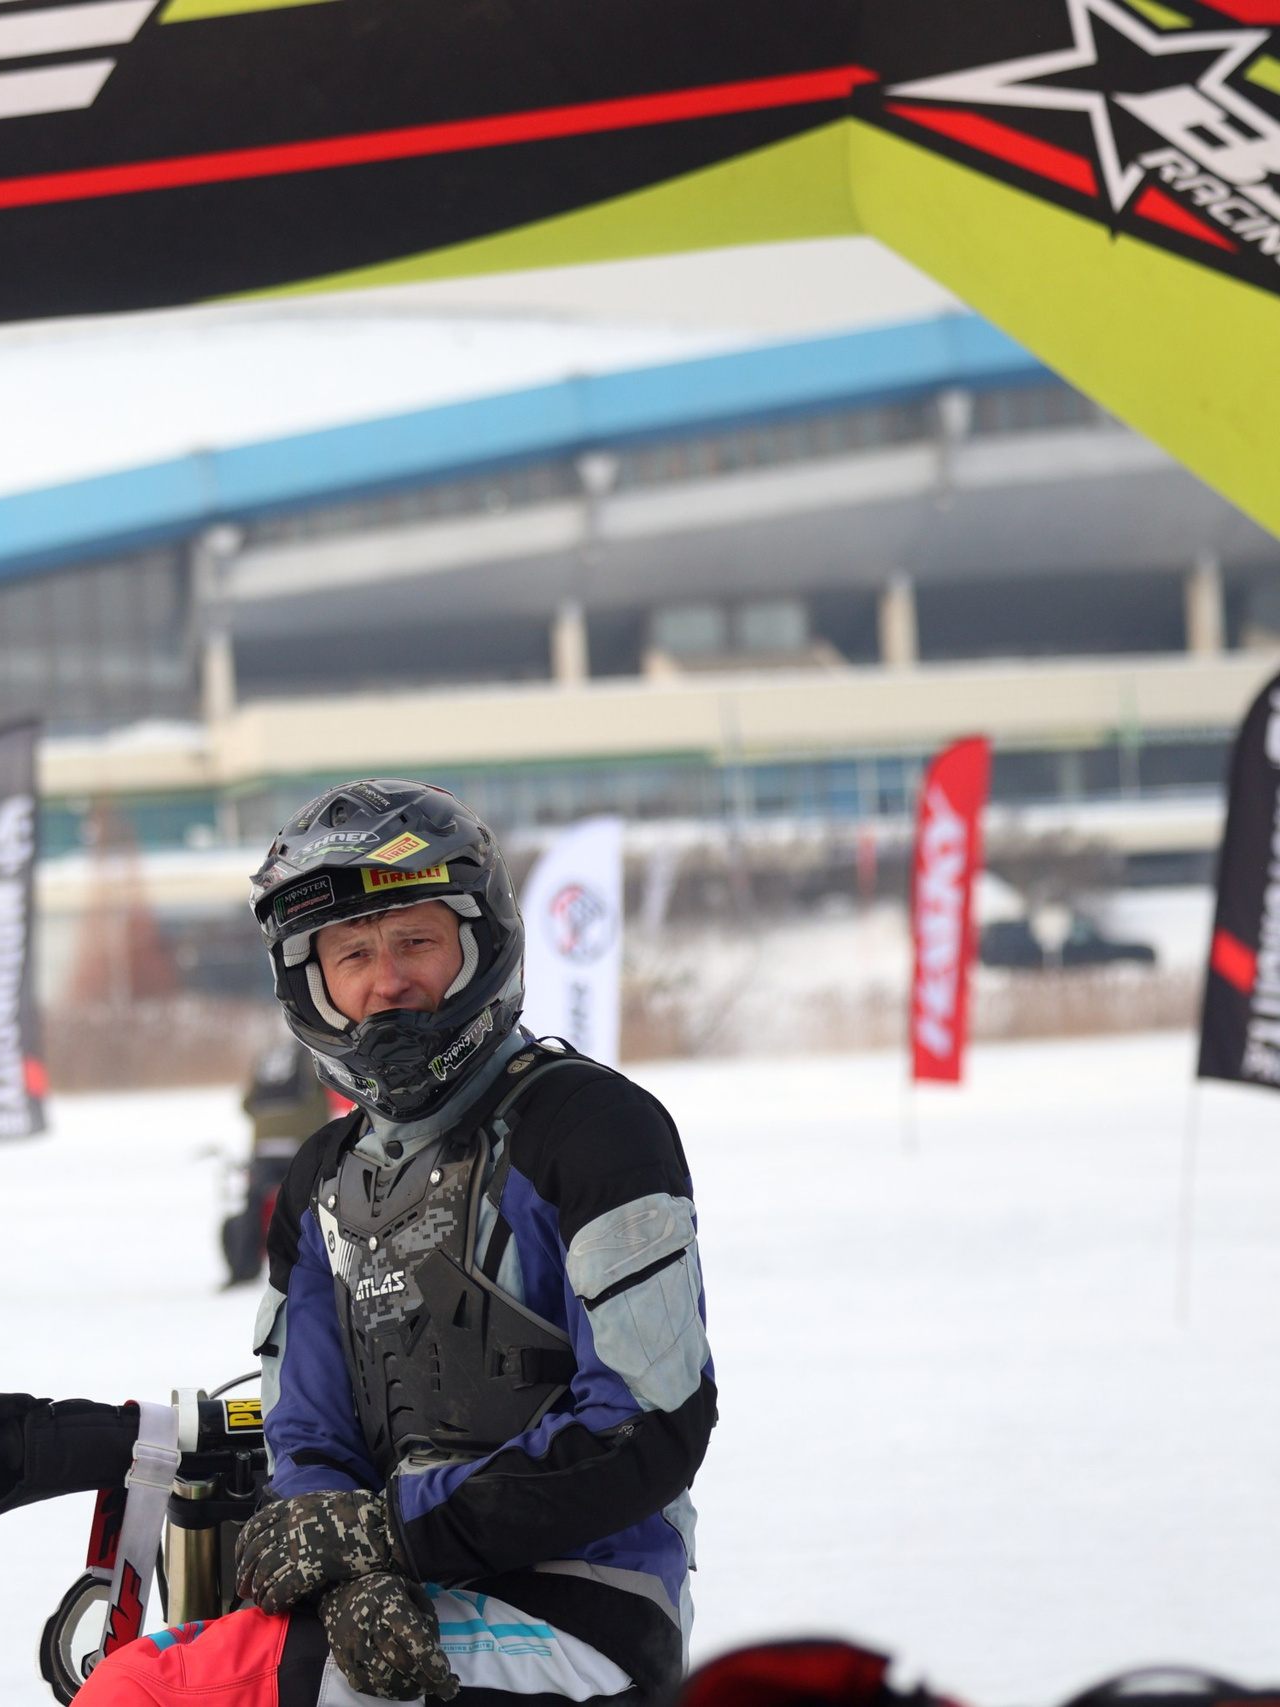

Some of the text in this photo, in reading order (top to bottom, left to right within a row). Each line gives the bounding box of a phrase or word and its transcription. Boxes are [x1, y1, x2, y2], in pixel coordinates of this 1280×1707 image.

[1138, 147, 1280, 268] RACIN
[301, 833, 368, 856] SHOEI
[375, 836, 421, 861] PIRELLI
[284, 880, 328, 903] MONSTER
[355, 1270, 405, 1301] ATLAS
[227, 1399, 264, 1427] PR
